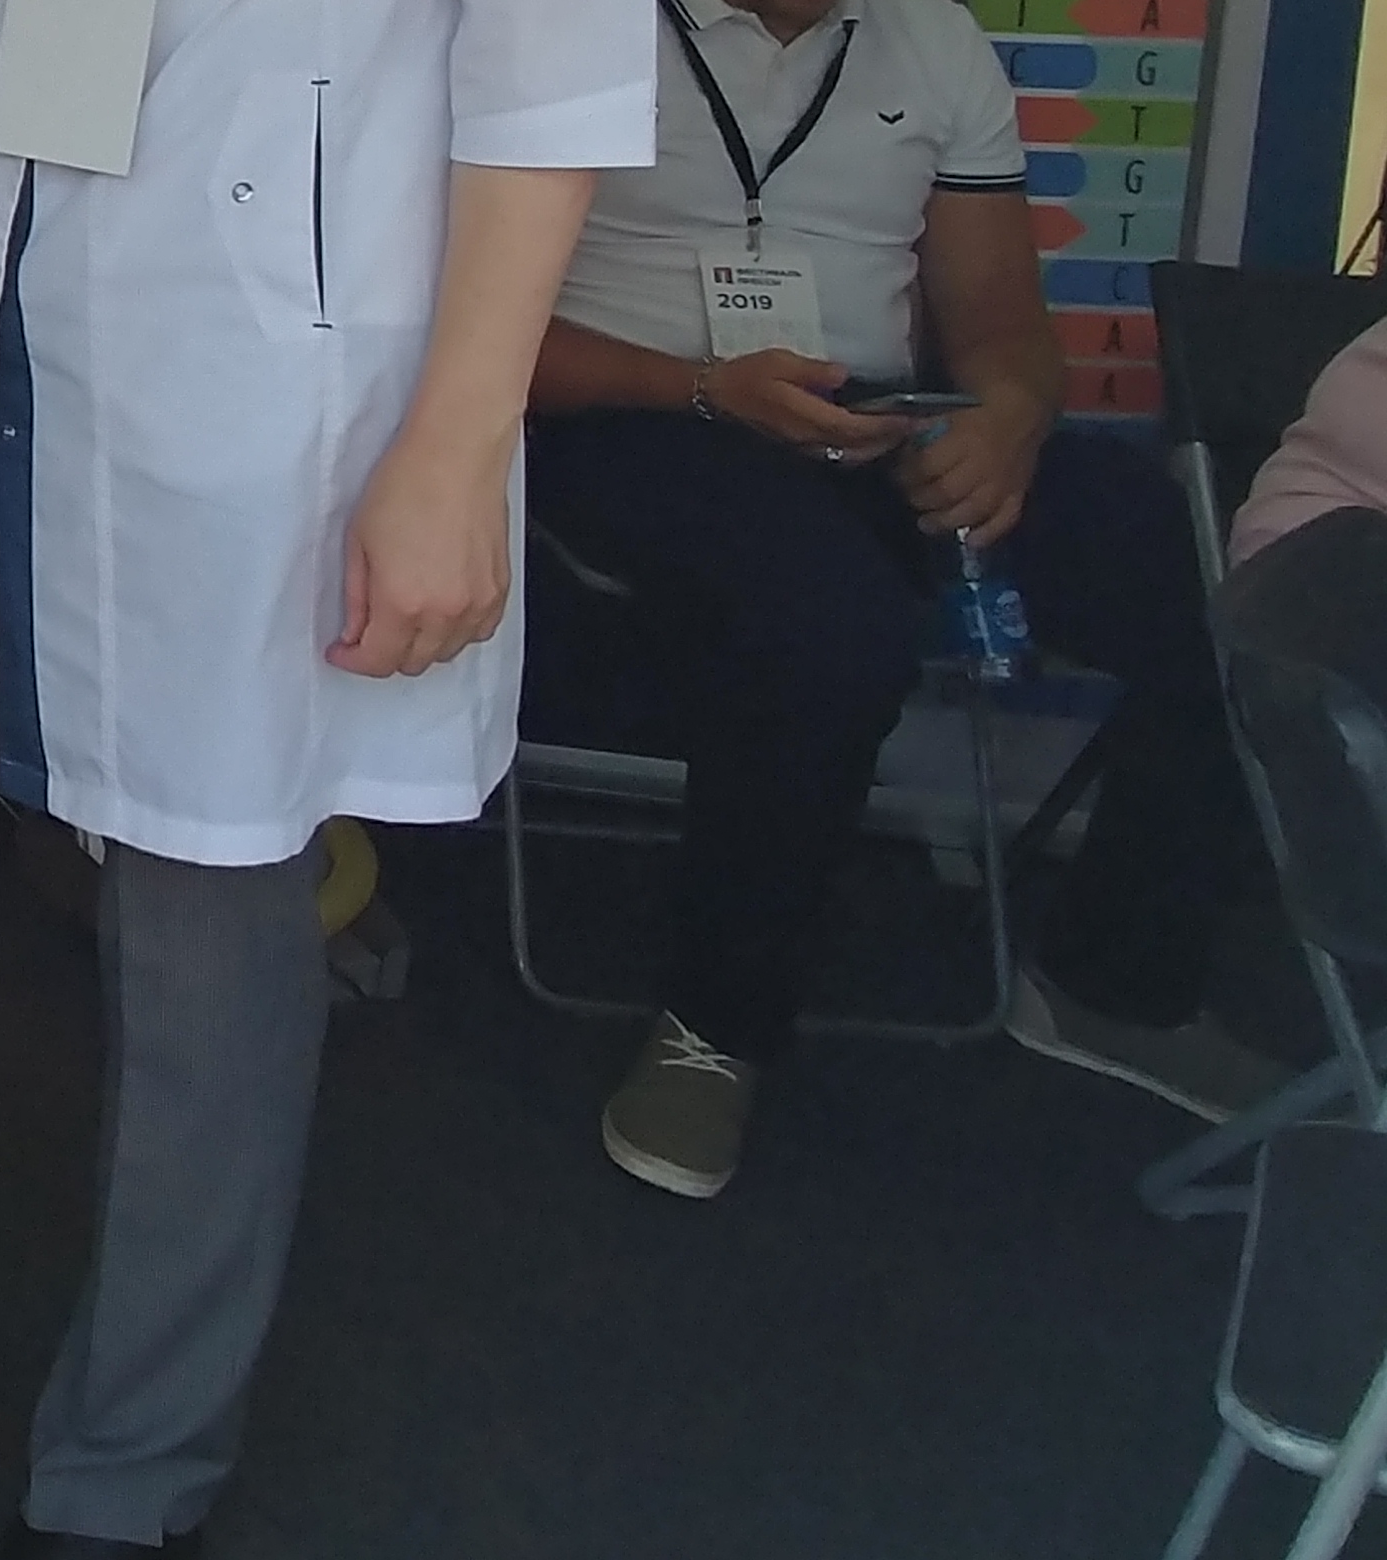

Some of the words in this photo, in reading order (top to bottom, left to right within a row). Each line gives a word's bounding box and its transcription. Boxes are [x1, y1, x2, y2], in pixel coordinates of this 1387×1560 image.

[1136, 51, 1158, 86] G
[1131, 105, 1147, 140] T
[1125, 160, 1146, 194] G
[1119, 213, 1135, 247] T
[717, 293, 773, 310] 2019
